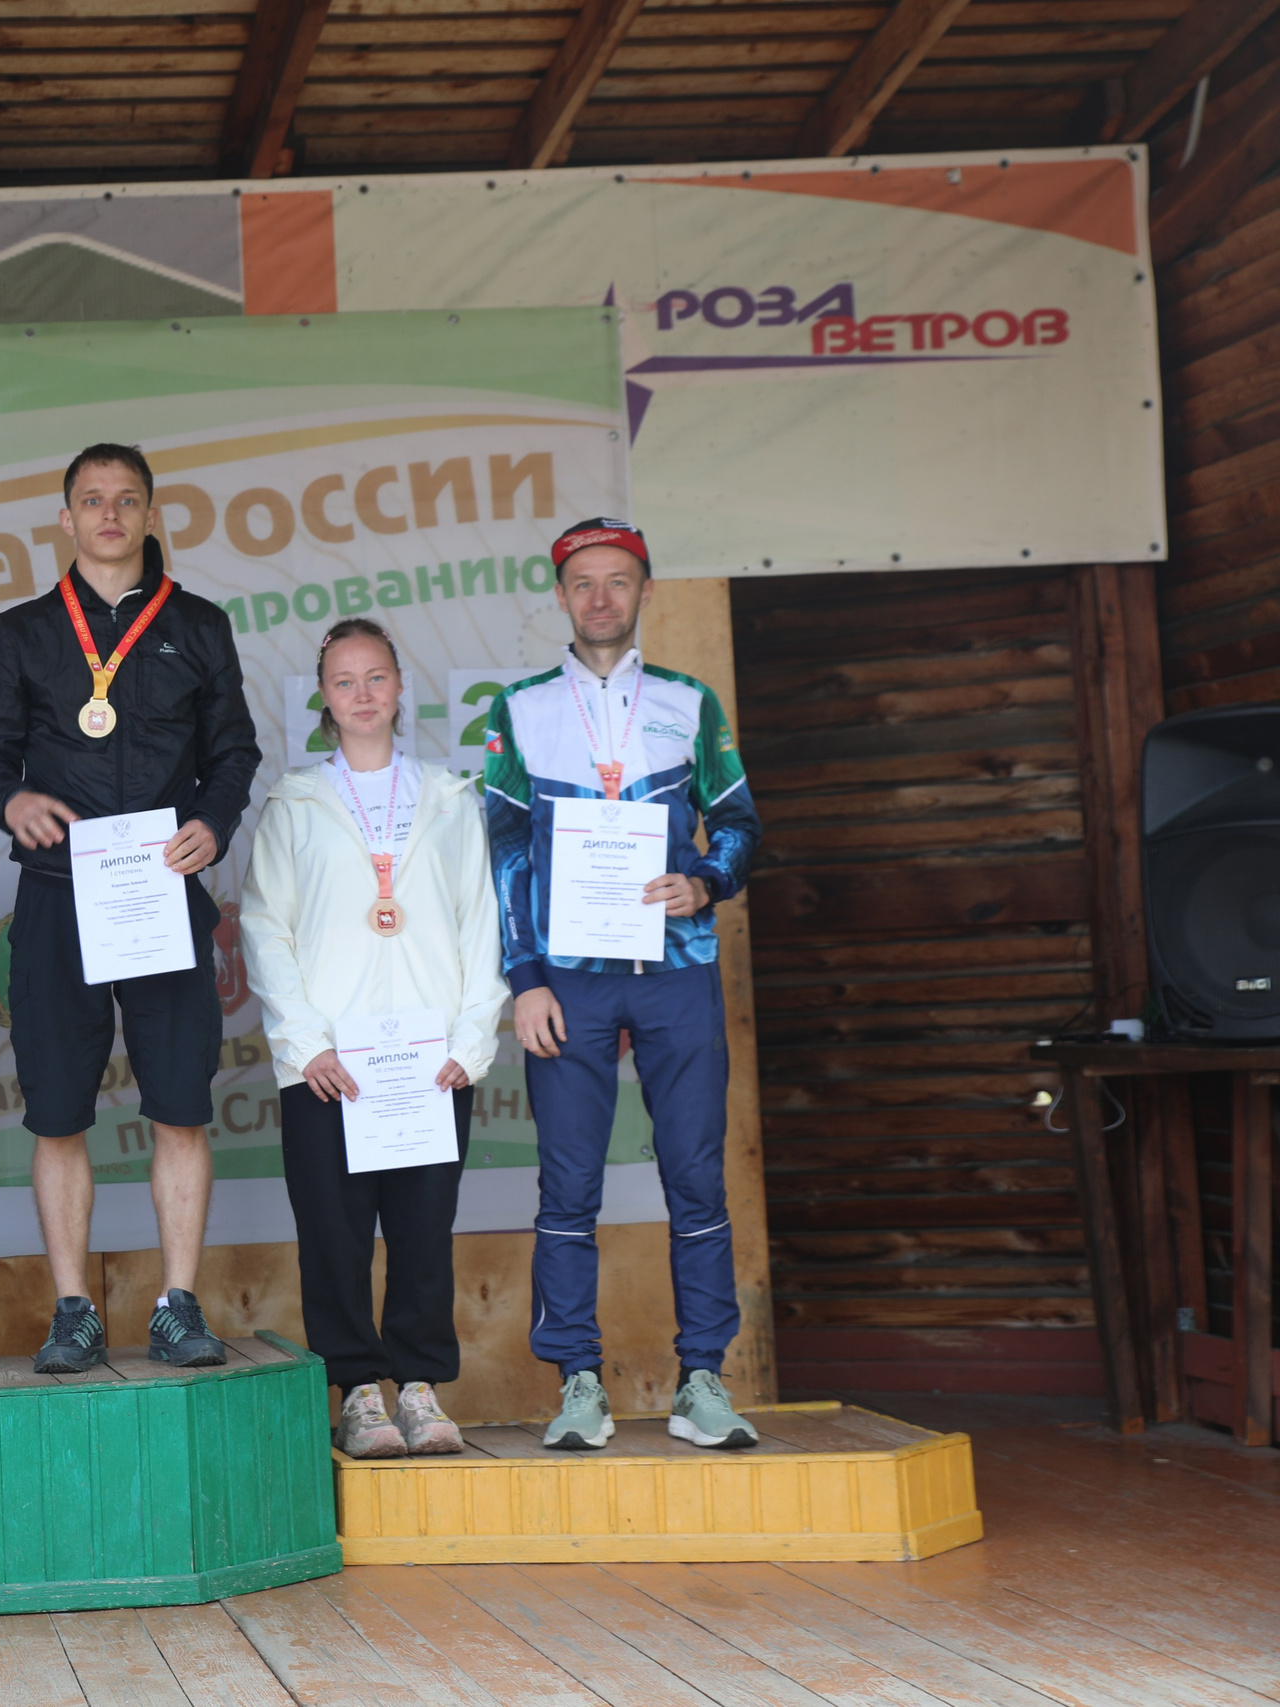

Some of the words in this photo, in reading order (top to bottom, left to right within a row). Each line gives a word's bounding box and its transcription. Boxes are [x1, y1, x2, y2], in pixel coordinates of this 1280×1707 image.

[655, 282, 855, 330] РОЗА
[810, 307, 1069, 355] ВЕТРОВ
[68, 590, 89, 642] ЧЕЛЯБИНСКАЯ
[582, 840, 637, 850] ДИПЛОМ
[100, 853, 151, 870] ДИПЛОМ
[114, 868, 143, 876] степень
[367, 1051, 419, 1066] ДИПЛОМ
